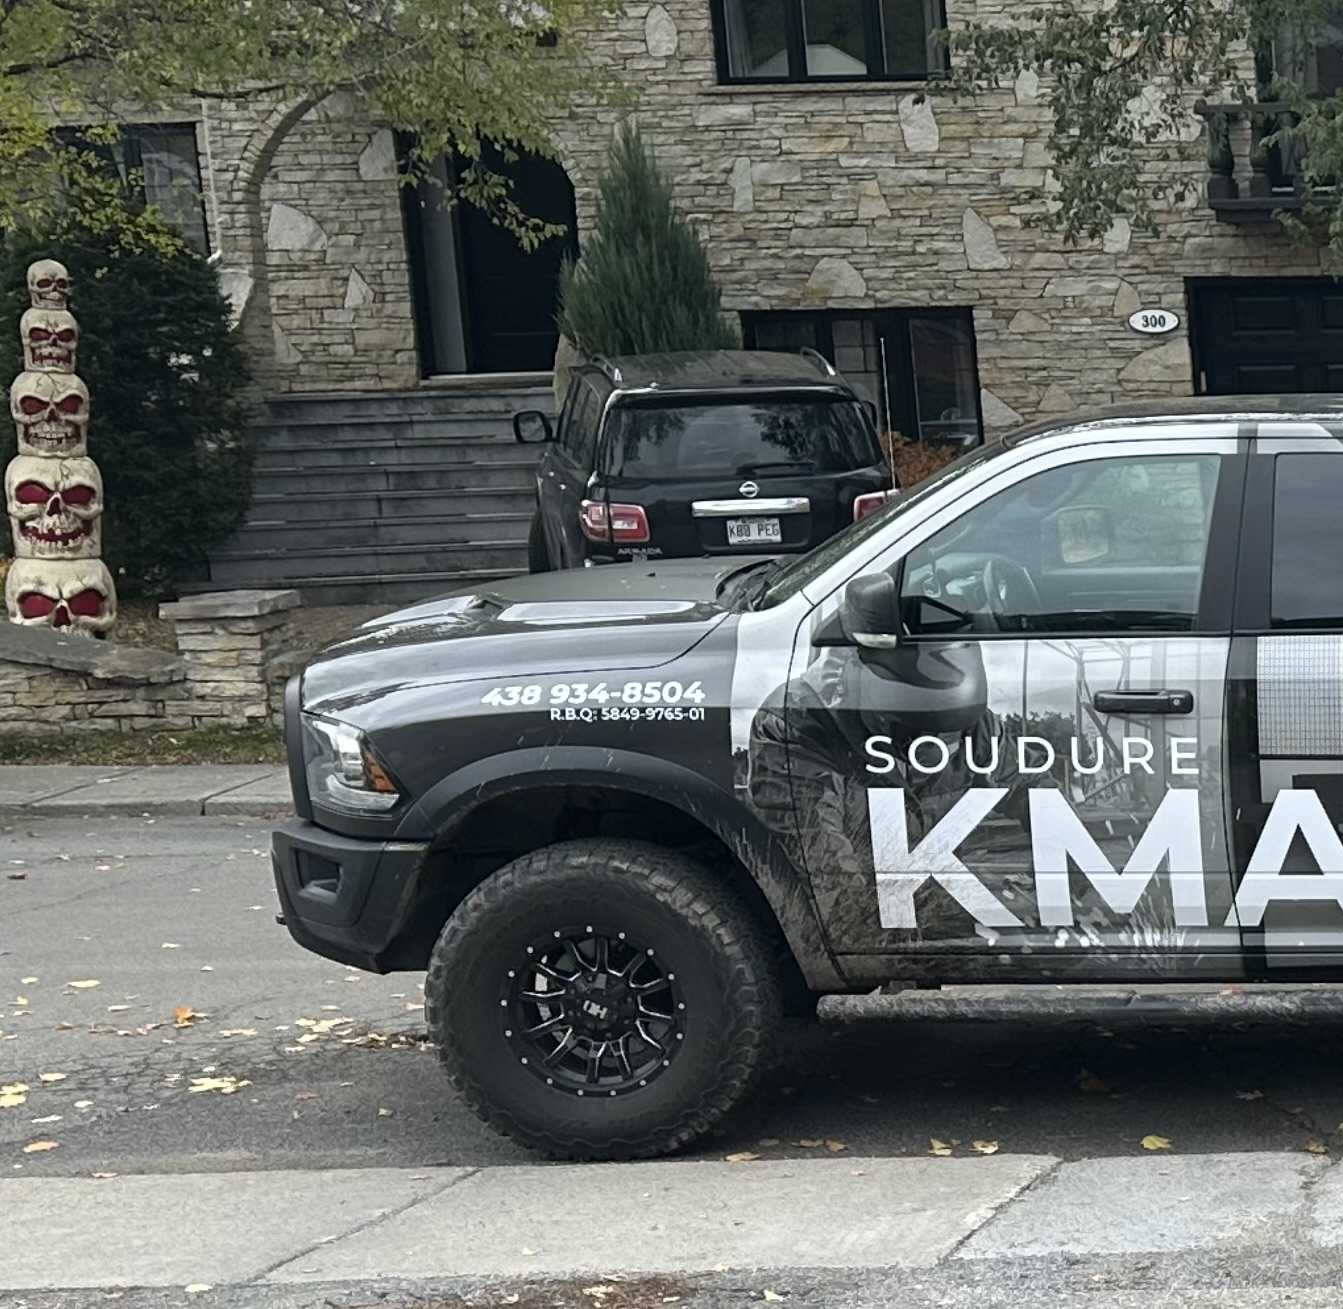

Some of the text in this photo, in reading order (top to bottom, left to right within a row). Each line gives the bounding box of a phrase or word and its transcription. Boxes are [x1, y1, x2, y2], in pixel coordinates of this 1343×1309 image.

[1141, 314, 1166, 328] 300
[757, 522, 780, 537] PEG
[480, 680, 706, 705] 438 934-8504
[601, 707, 705, 721] 5849-9765-01
[864, 735, 1200, 775] SOUDURE
